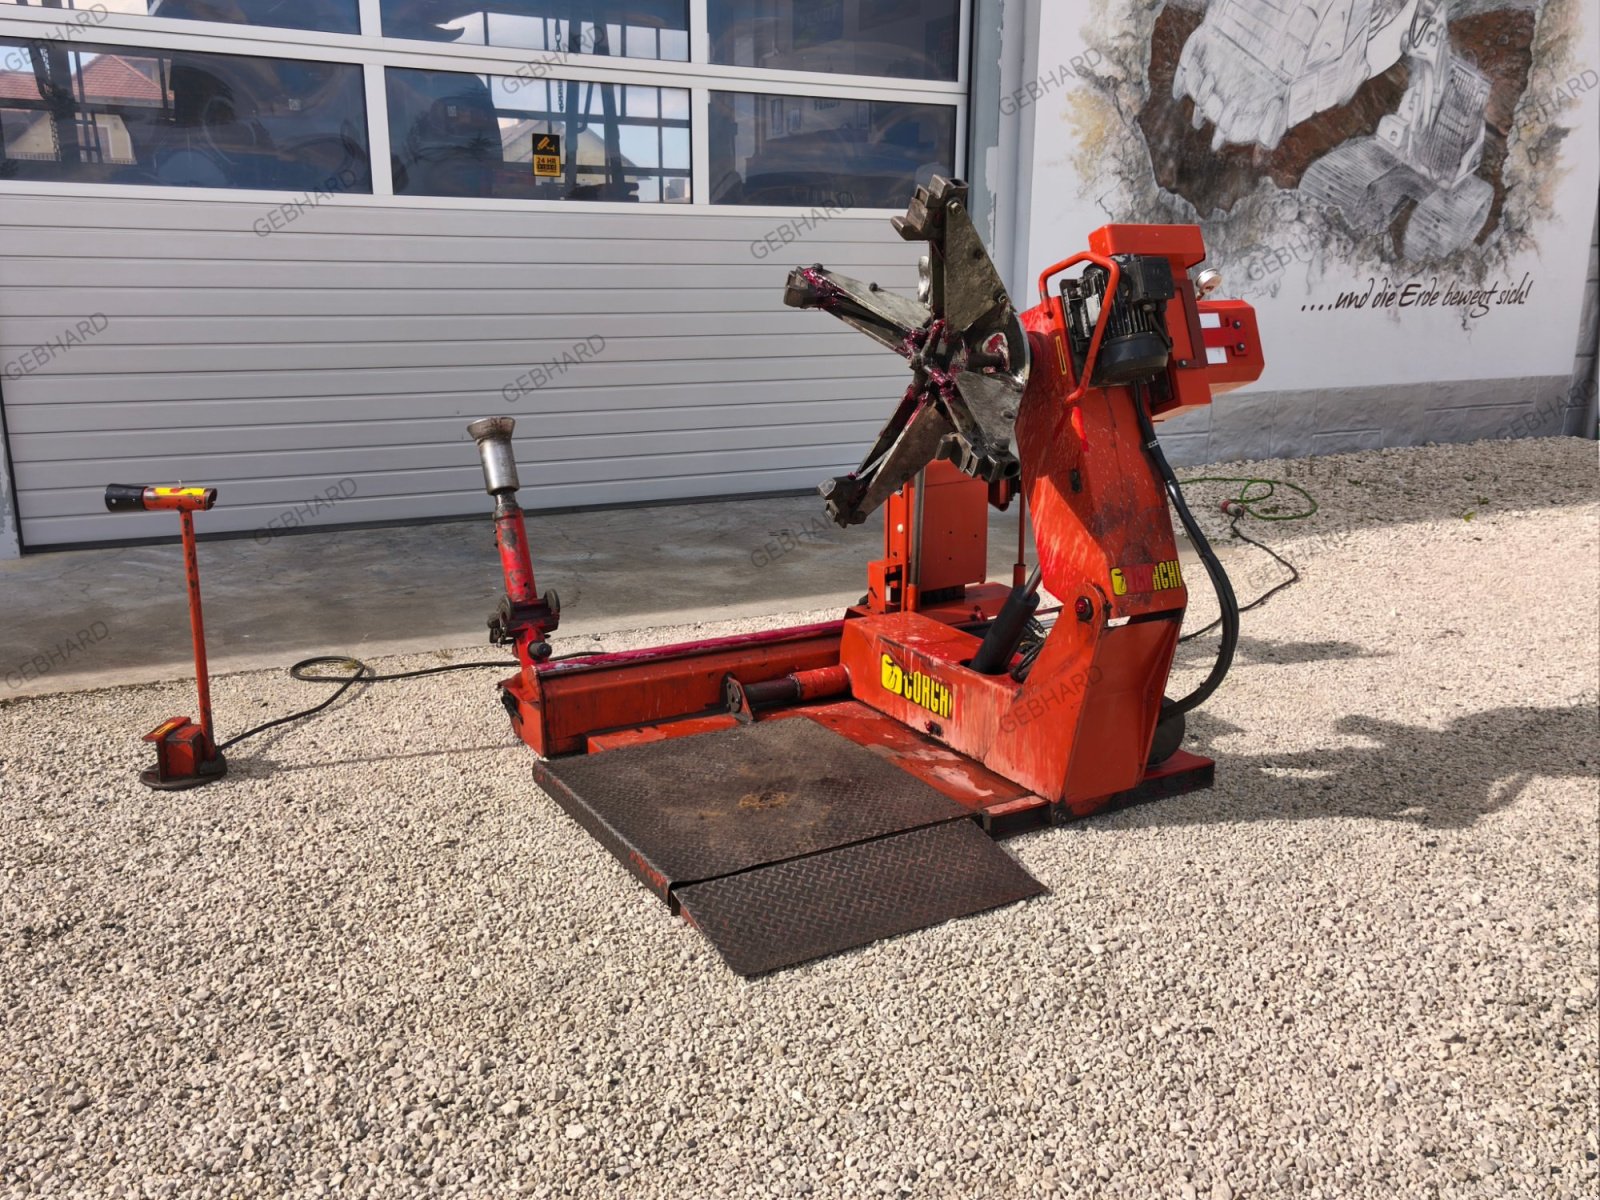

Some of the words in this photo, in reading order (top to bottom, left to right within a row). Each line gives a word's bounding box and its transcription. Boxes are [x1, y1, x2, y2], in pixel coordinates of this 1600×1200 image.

[1372, 277, 1395, 308] die
[1399, 277, 1437, 307] Erde
[1442, 281, 1499, 318] bewegt
[1496, 272, 1534, 305] sich!
